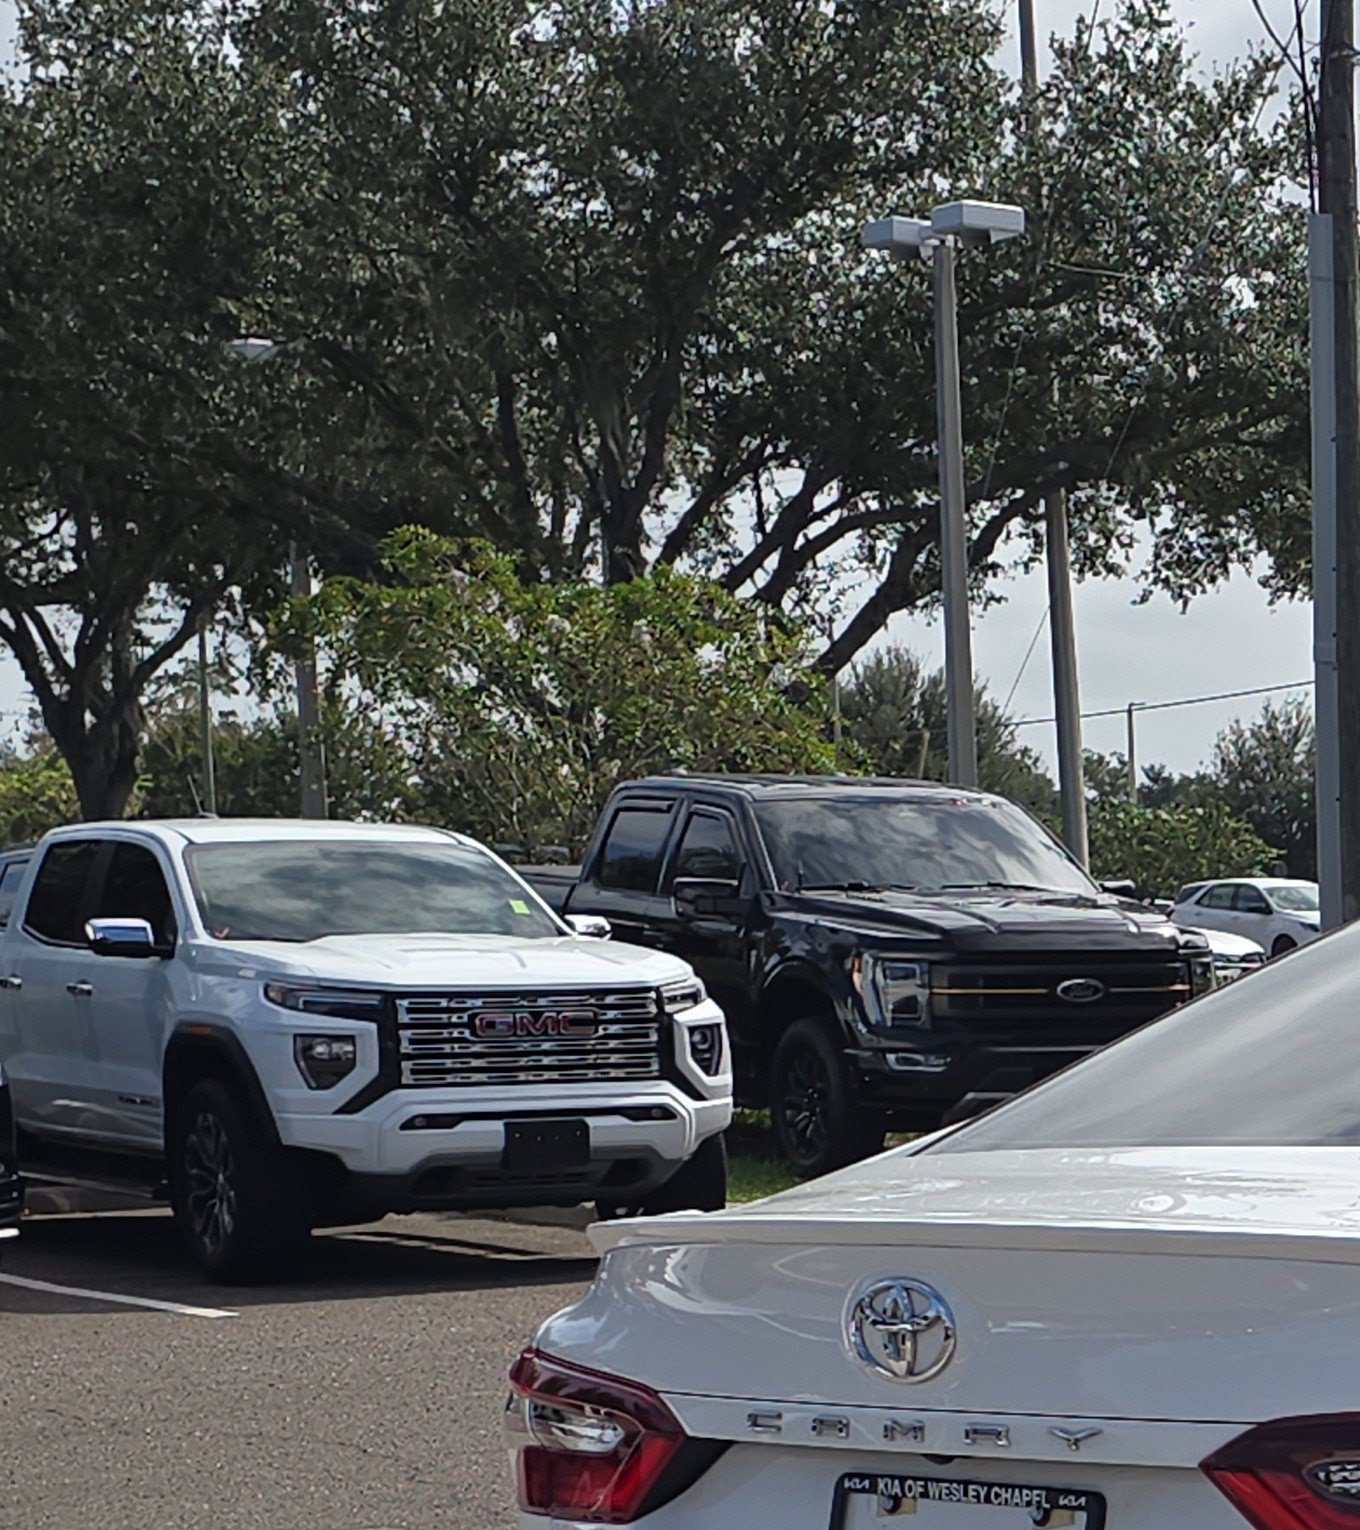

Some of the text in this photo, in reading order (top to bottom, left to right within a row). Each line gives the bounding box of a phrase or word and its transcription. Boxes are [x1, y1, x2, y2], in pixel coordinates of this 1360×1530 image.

[475, 1012, 596, 1037] GMC
[746, 1409, 1102, 1451] CAMRY
[877, 1477, 903, 1498] KIA
[904, 1480, 926, 1498] OF
[926, 1481, 989, 1504] WESLEY
[990, 1485, 1051, 1509] CHAPEL
